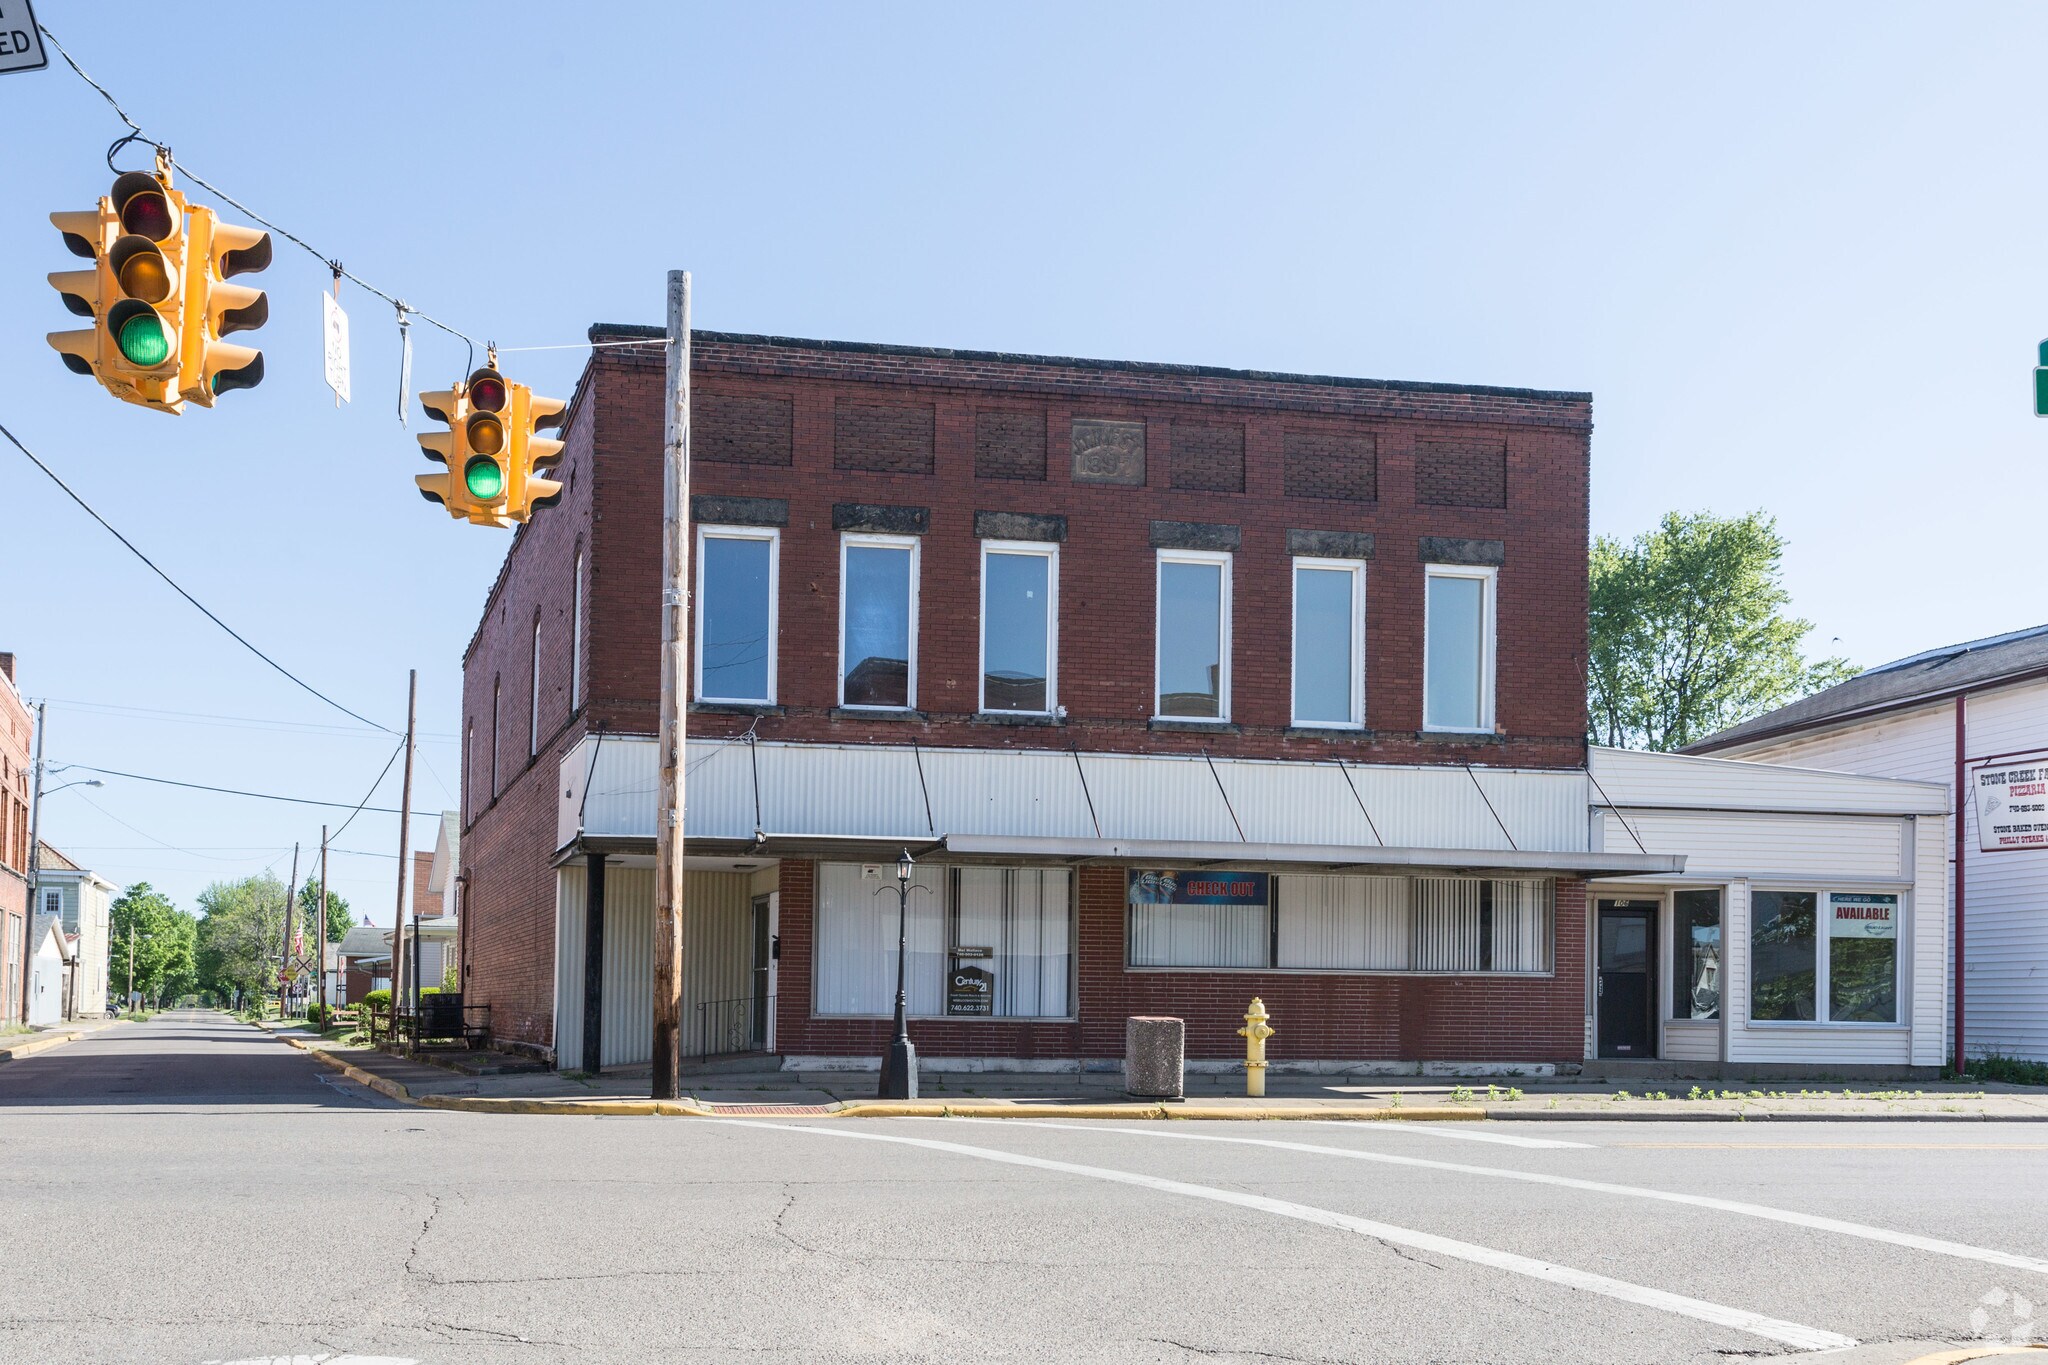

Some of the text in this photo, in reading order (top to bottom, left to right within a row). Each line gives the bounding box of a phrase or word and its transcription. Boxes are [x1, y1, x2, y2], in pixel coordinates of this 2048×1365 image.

[1980, 772, 2006, 786] STONE
[2008, 769, 2036, 783] CREEK
[2009, 783, 2046, 797] PIZZARIA
[1993, 826, 2011, 834] STONE
[2012, 824, 2032, 833] BAKED
[1999, 835, 2044, 845] PHILLY STEAKS
[1187, 881, 1255, 897] CHECK OUT
[1836, 907, 1890, 920] AVAILABLE
[979, 983, 987, 992] 21
